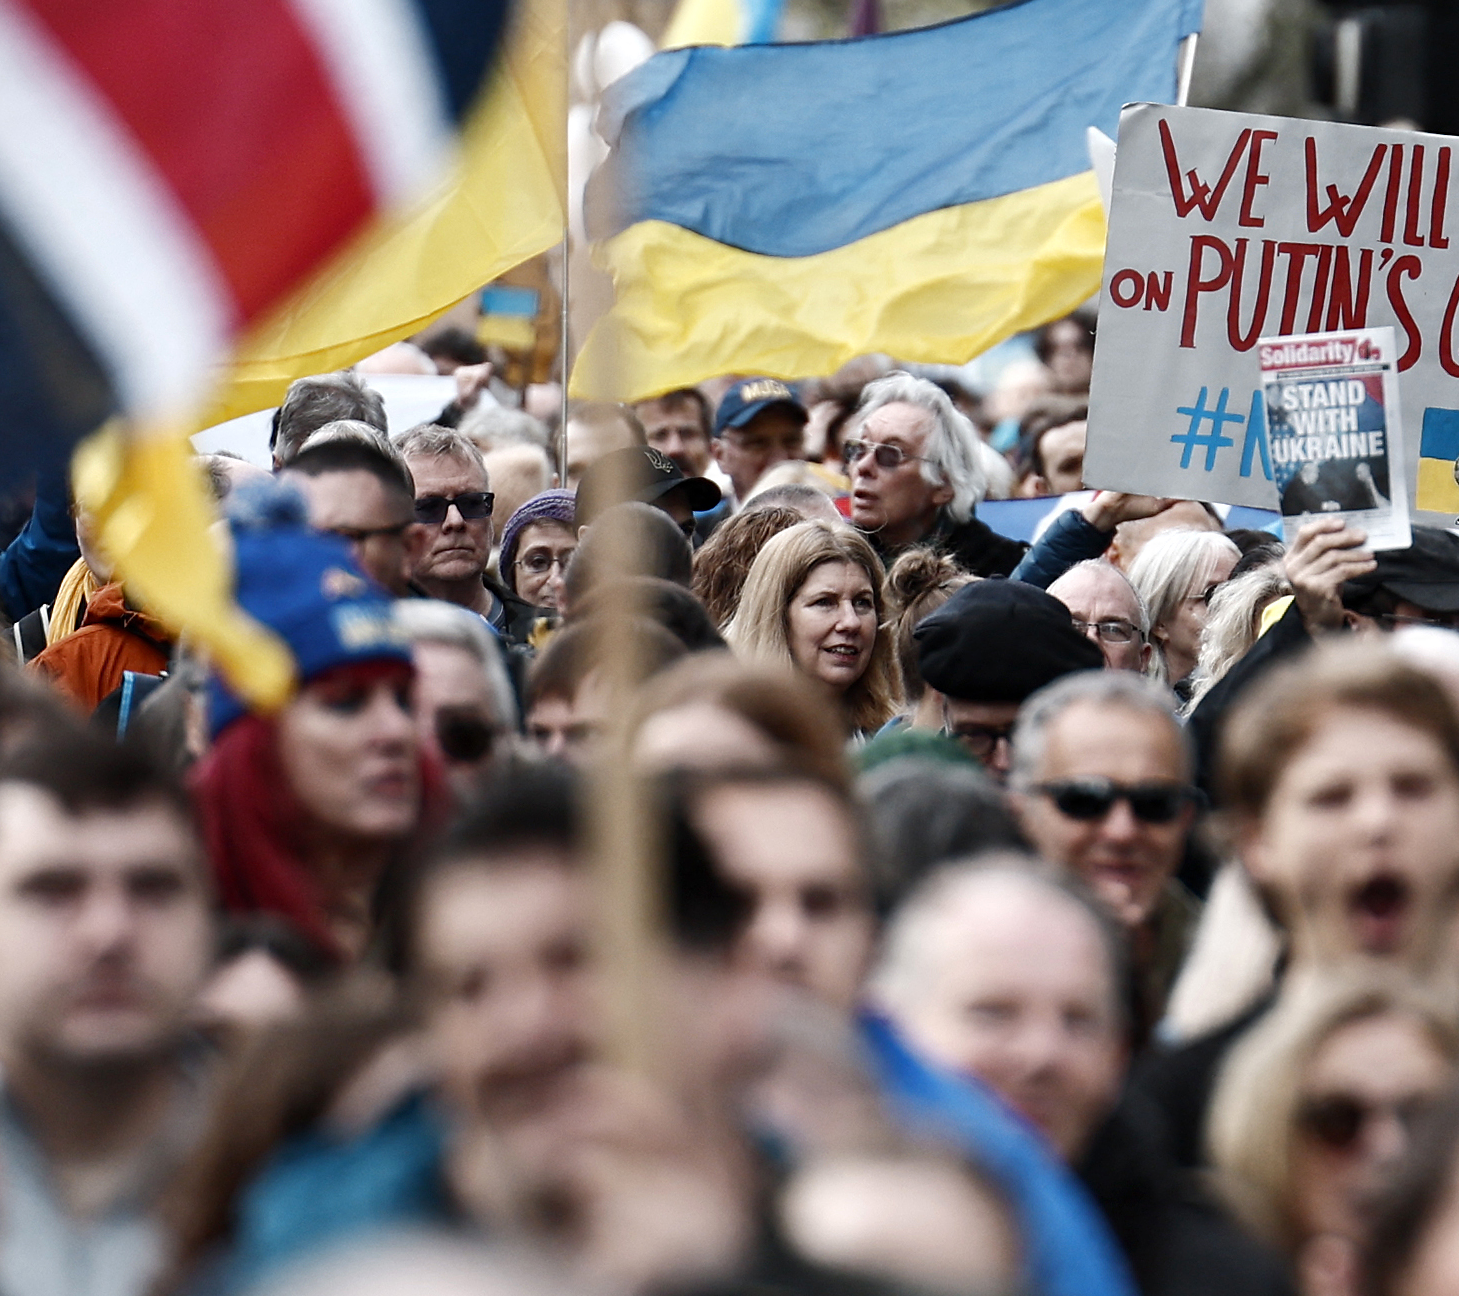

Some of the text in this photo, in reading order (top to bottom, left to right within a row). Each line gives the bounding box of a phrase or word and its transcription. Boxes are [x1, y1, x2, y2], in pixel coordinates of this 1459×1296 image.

[1158, 118, 1279, 228] WE
[1304, 136, 1451, 250] WILL
[1109, 268, 1175, 312] ON
[1180, 234, 1422, 373] PUTIN'S
[1260, 340, 1355, 367] Solidarity
[1282, 379, 1367, 411] STAND
[1289, 405, 1359, 436] WITH
[1272, 429, 1385, 464] UKRAINE
